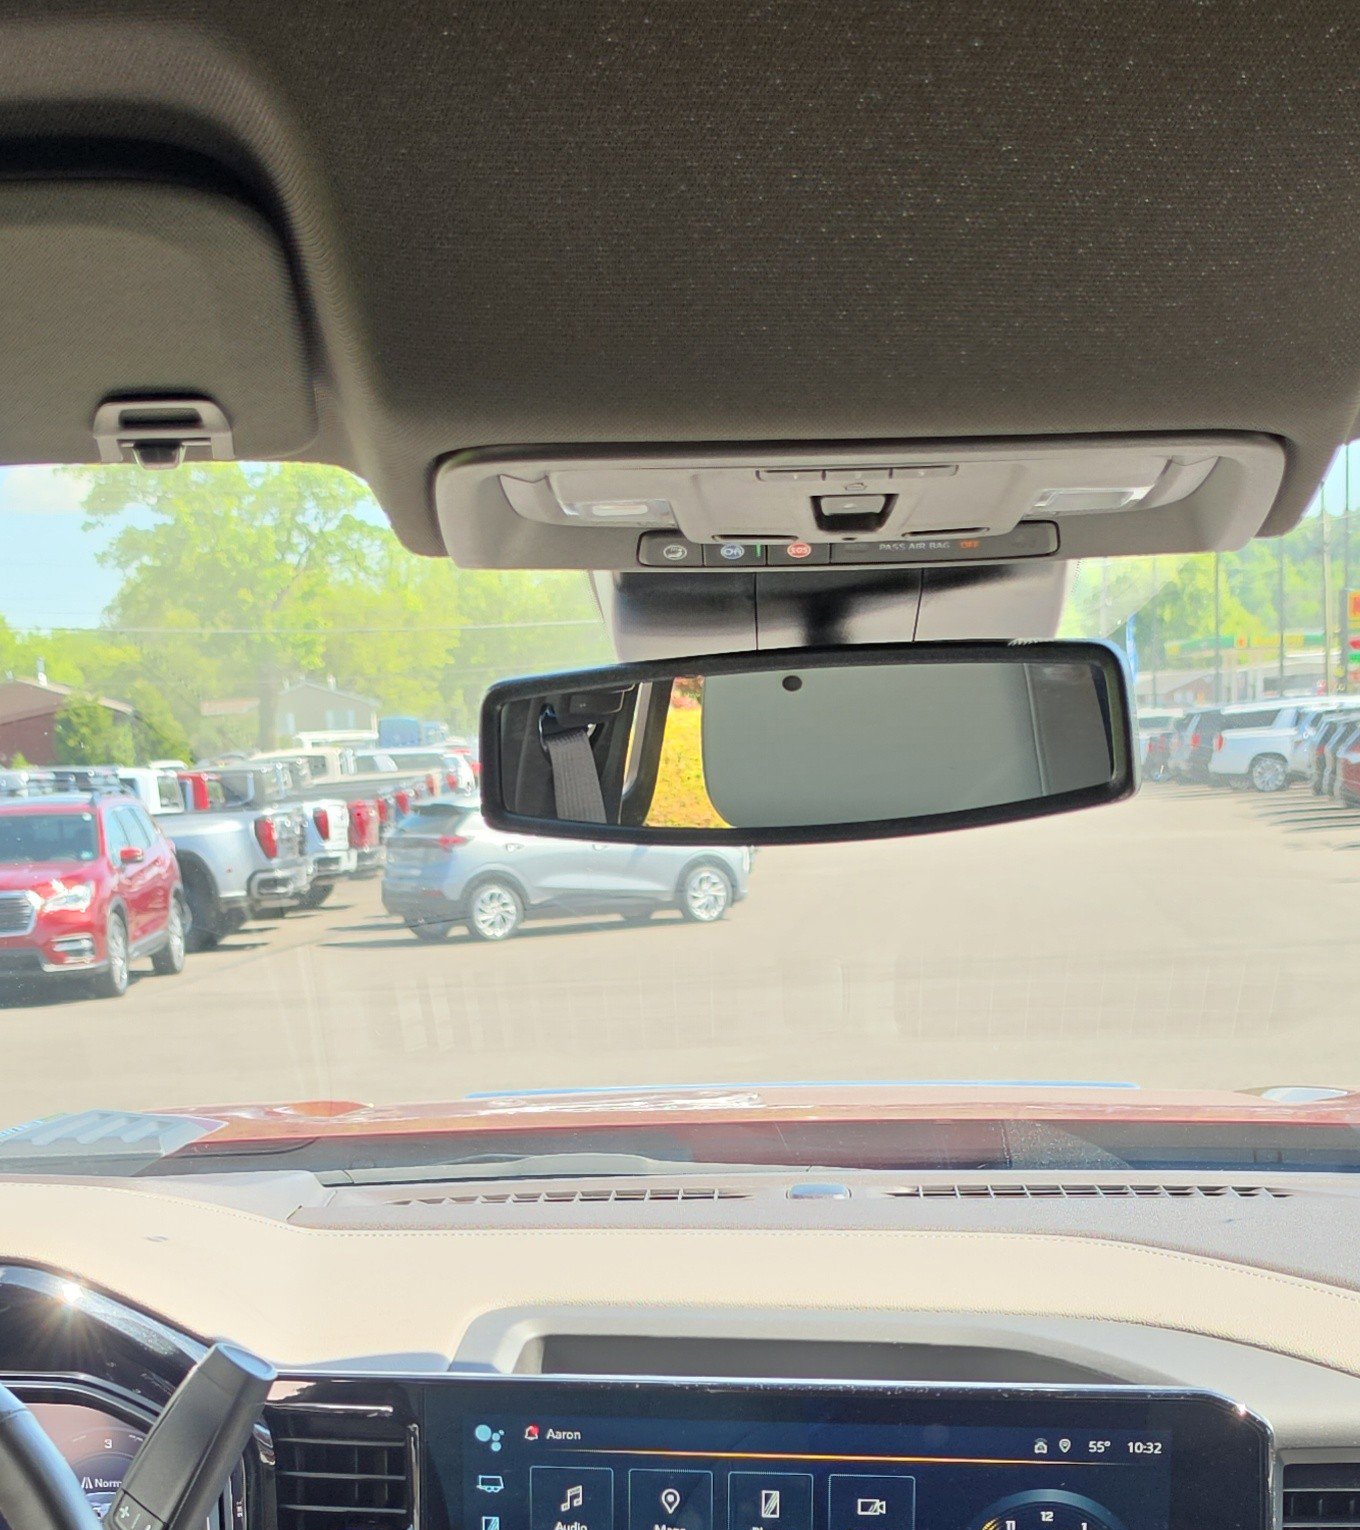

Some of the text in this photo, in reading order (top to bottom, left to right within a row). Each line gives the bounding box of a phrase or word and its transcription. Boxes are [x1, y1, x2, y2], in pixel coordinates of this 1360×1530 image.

[546, 1428, 581, 1441] Aaron
[104, 1438, 114, 1449] 3
[1127, 1441, 1163, 1454] 10:32
[1040, 1511, 1054, 1522] 12
[1005, 1520, 1016, 1530] 11
